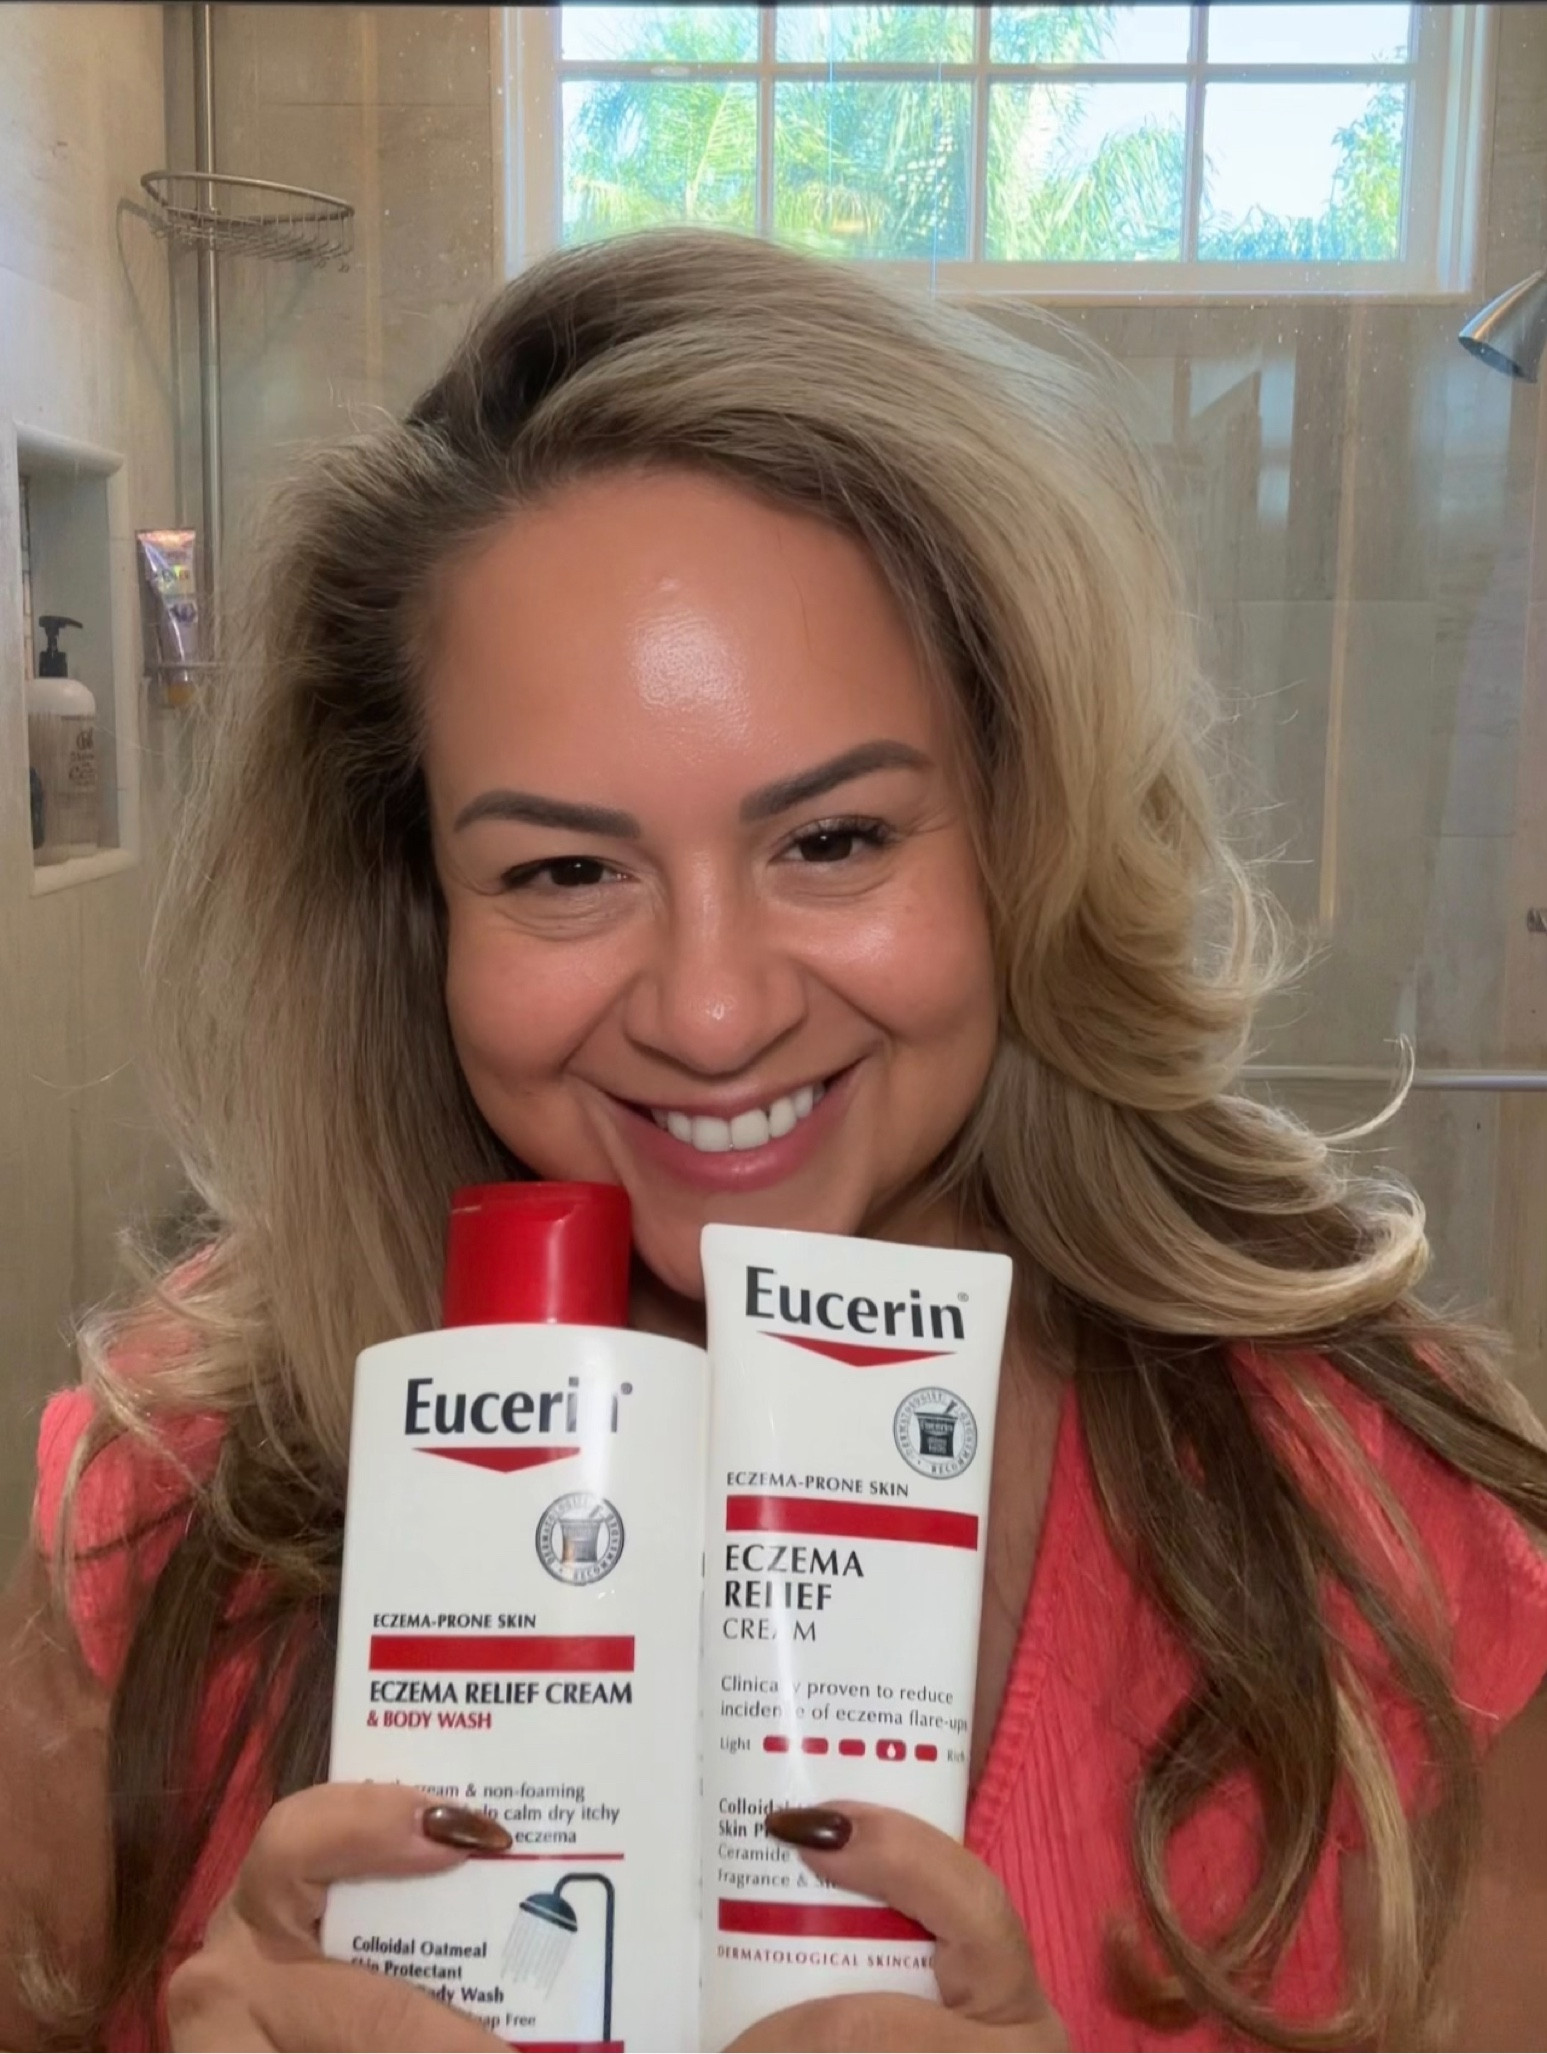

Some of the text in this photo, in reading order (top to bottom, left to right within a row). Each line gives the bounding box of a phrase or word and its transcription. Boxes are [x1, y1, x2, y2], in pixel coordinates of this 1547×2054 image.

[746, 1266, 965, 1339] Eucerin
[726, 1471, 909, 1497] ECZEMA-PRONE SKIN
[725, 1544, 864, 1577] ECZEMA
[373, 1614, 537, 1629] ECZEMA-PRONE SKIN
[723, 1617, 817, 1641] CREM
[370, 1681, 633, 1704] ECZEMA RELIEF CREAM
[721, 1674, 954, 1704] Clinicay proven to reduce
[367, 1710, 491, 1729] & BODY WASH
[720, 1700, 805, 1718] incidene
[812, 1703, 830, 1720] of
[836, 1708, 903, 1725] eczema
[720, 1737, 751, 1754] Light
[415, 1782, 585, 1801] ream & non-foaming
[504, 1803, 542, 1820] calm
[548, 1804, 575, 1825] dry
[581, 1804, 620, 1825] itchy
[515, 1830, 576, 1844] eczema
[719, 1819, 747, 1837] Skin
[719, 1843, 790, 1862] Ceramide
[719, 1867, 790, 1888] Fragrance
[352, 1936, 487, 1958] Colloidal Oatmeal
[717, 1945, 858, 1967] DERMATOLOGICAL
[385, 1960, 462, 1979] Protectant
[461, 1985, 504, 2003] Wash
[506, 2012, 536, 2027] Free
